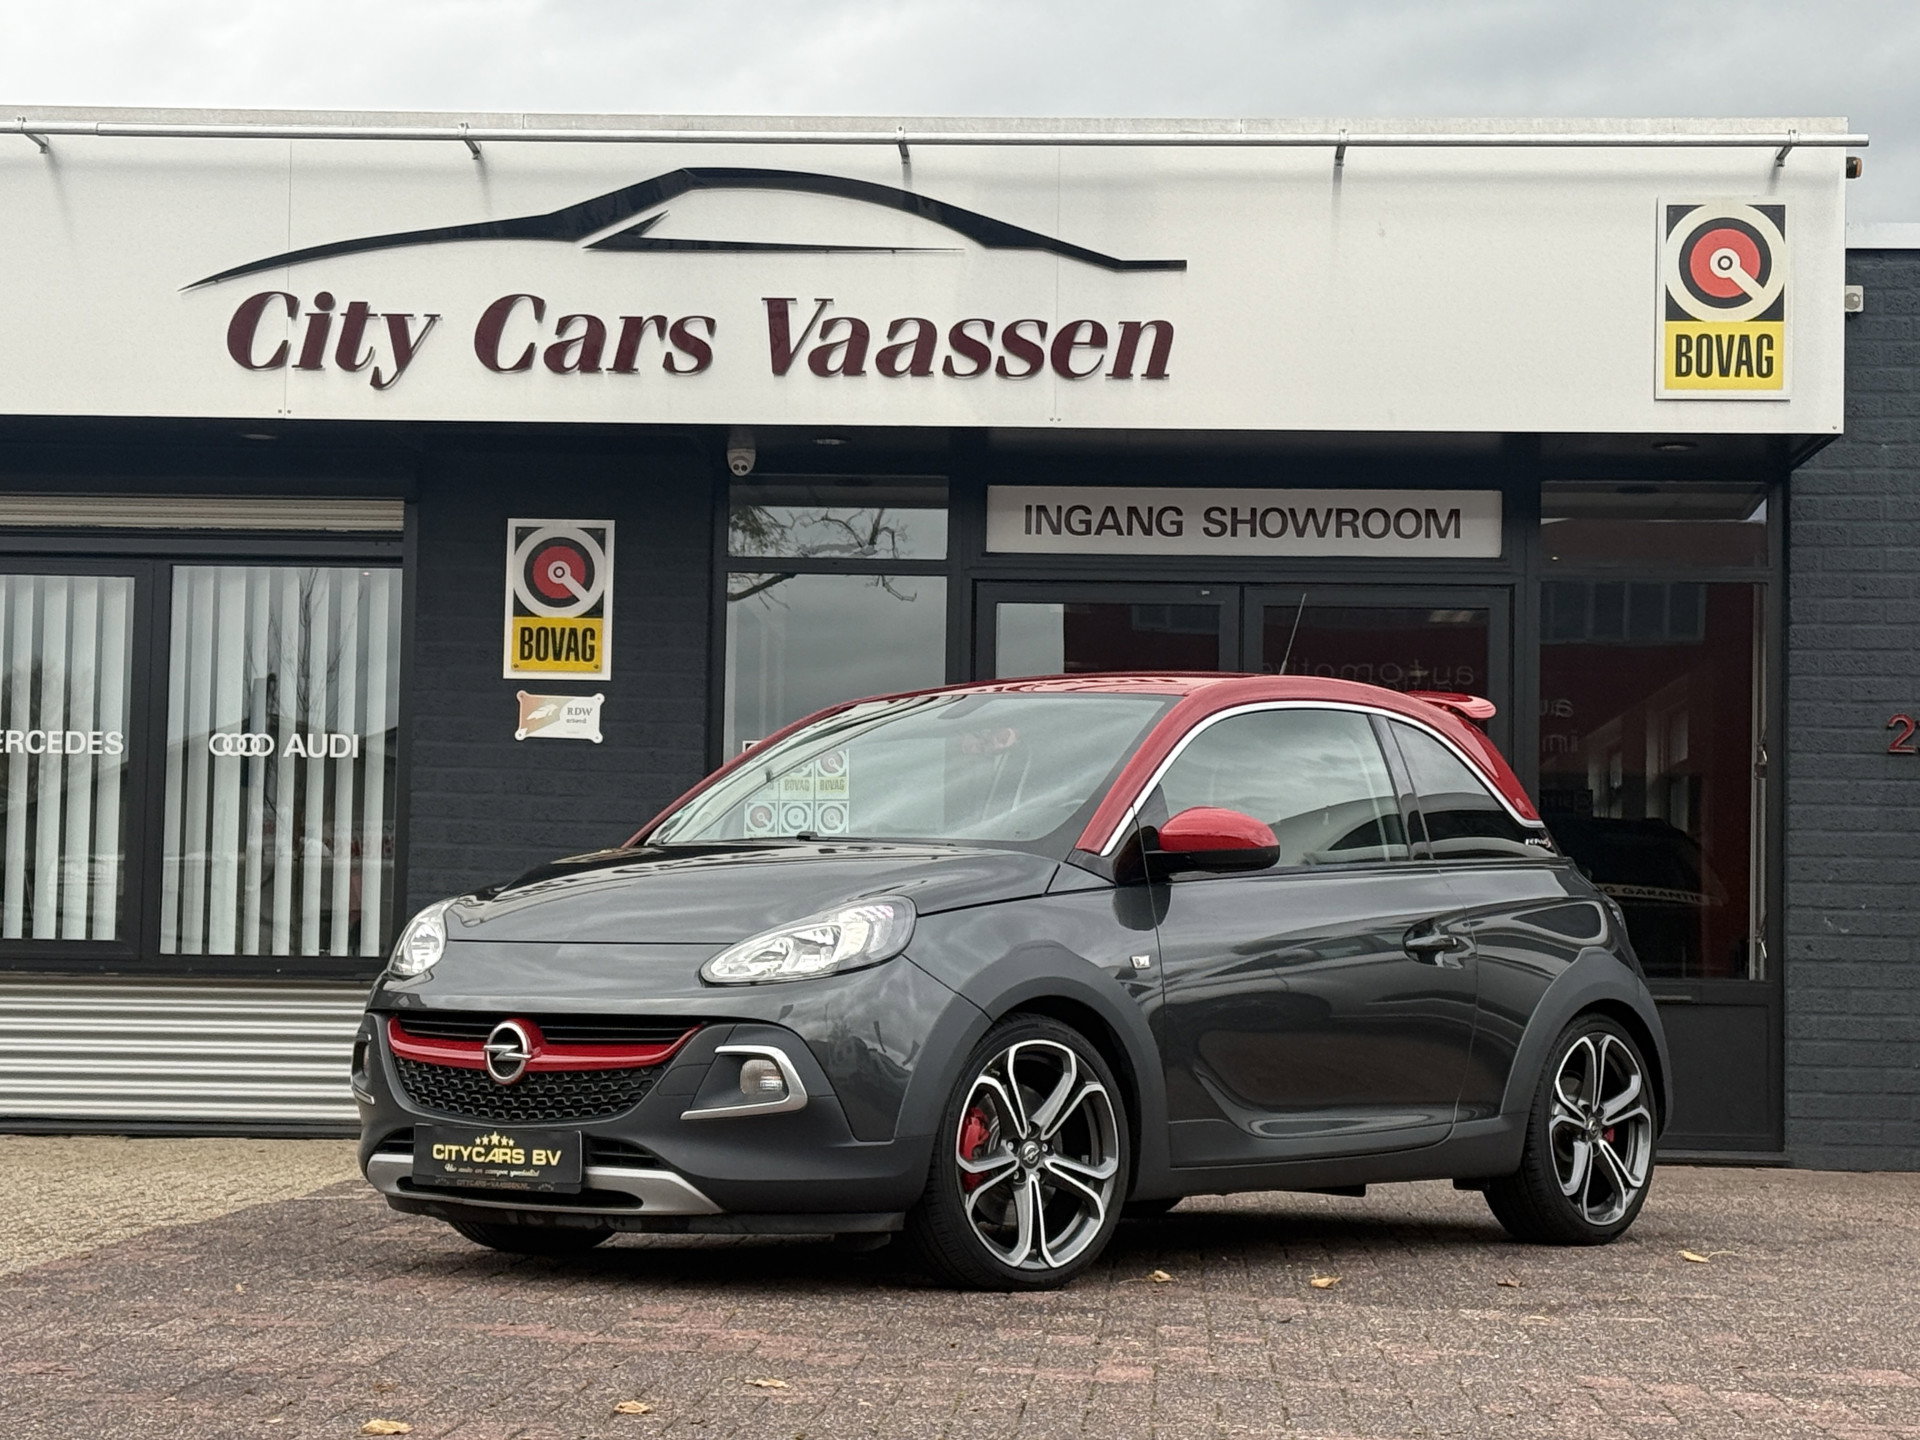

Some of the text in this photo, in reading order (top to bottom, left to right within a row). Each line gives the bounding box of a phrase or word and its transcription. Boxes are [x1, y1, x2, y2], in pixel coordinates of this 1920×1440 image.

[227, 291, 1175, 389] City Cars Vaassen
[1675, 334, 1774, 378] BOVAG
[1024, 505, 1461, 539] INGANG SHOWROOM
[520, 627, 595, 662] BOVAG
[567, 707, 593, 716] RDW
[283, 734, 359, 758] AUDI
[1888, 713, 1916, 752] 2
[820, 779, 845, 791] BOVAG
[432, 1144, 562, 1166] CITYCARS BV
